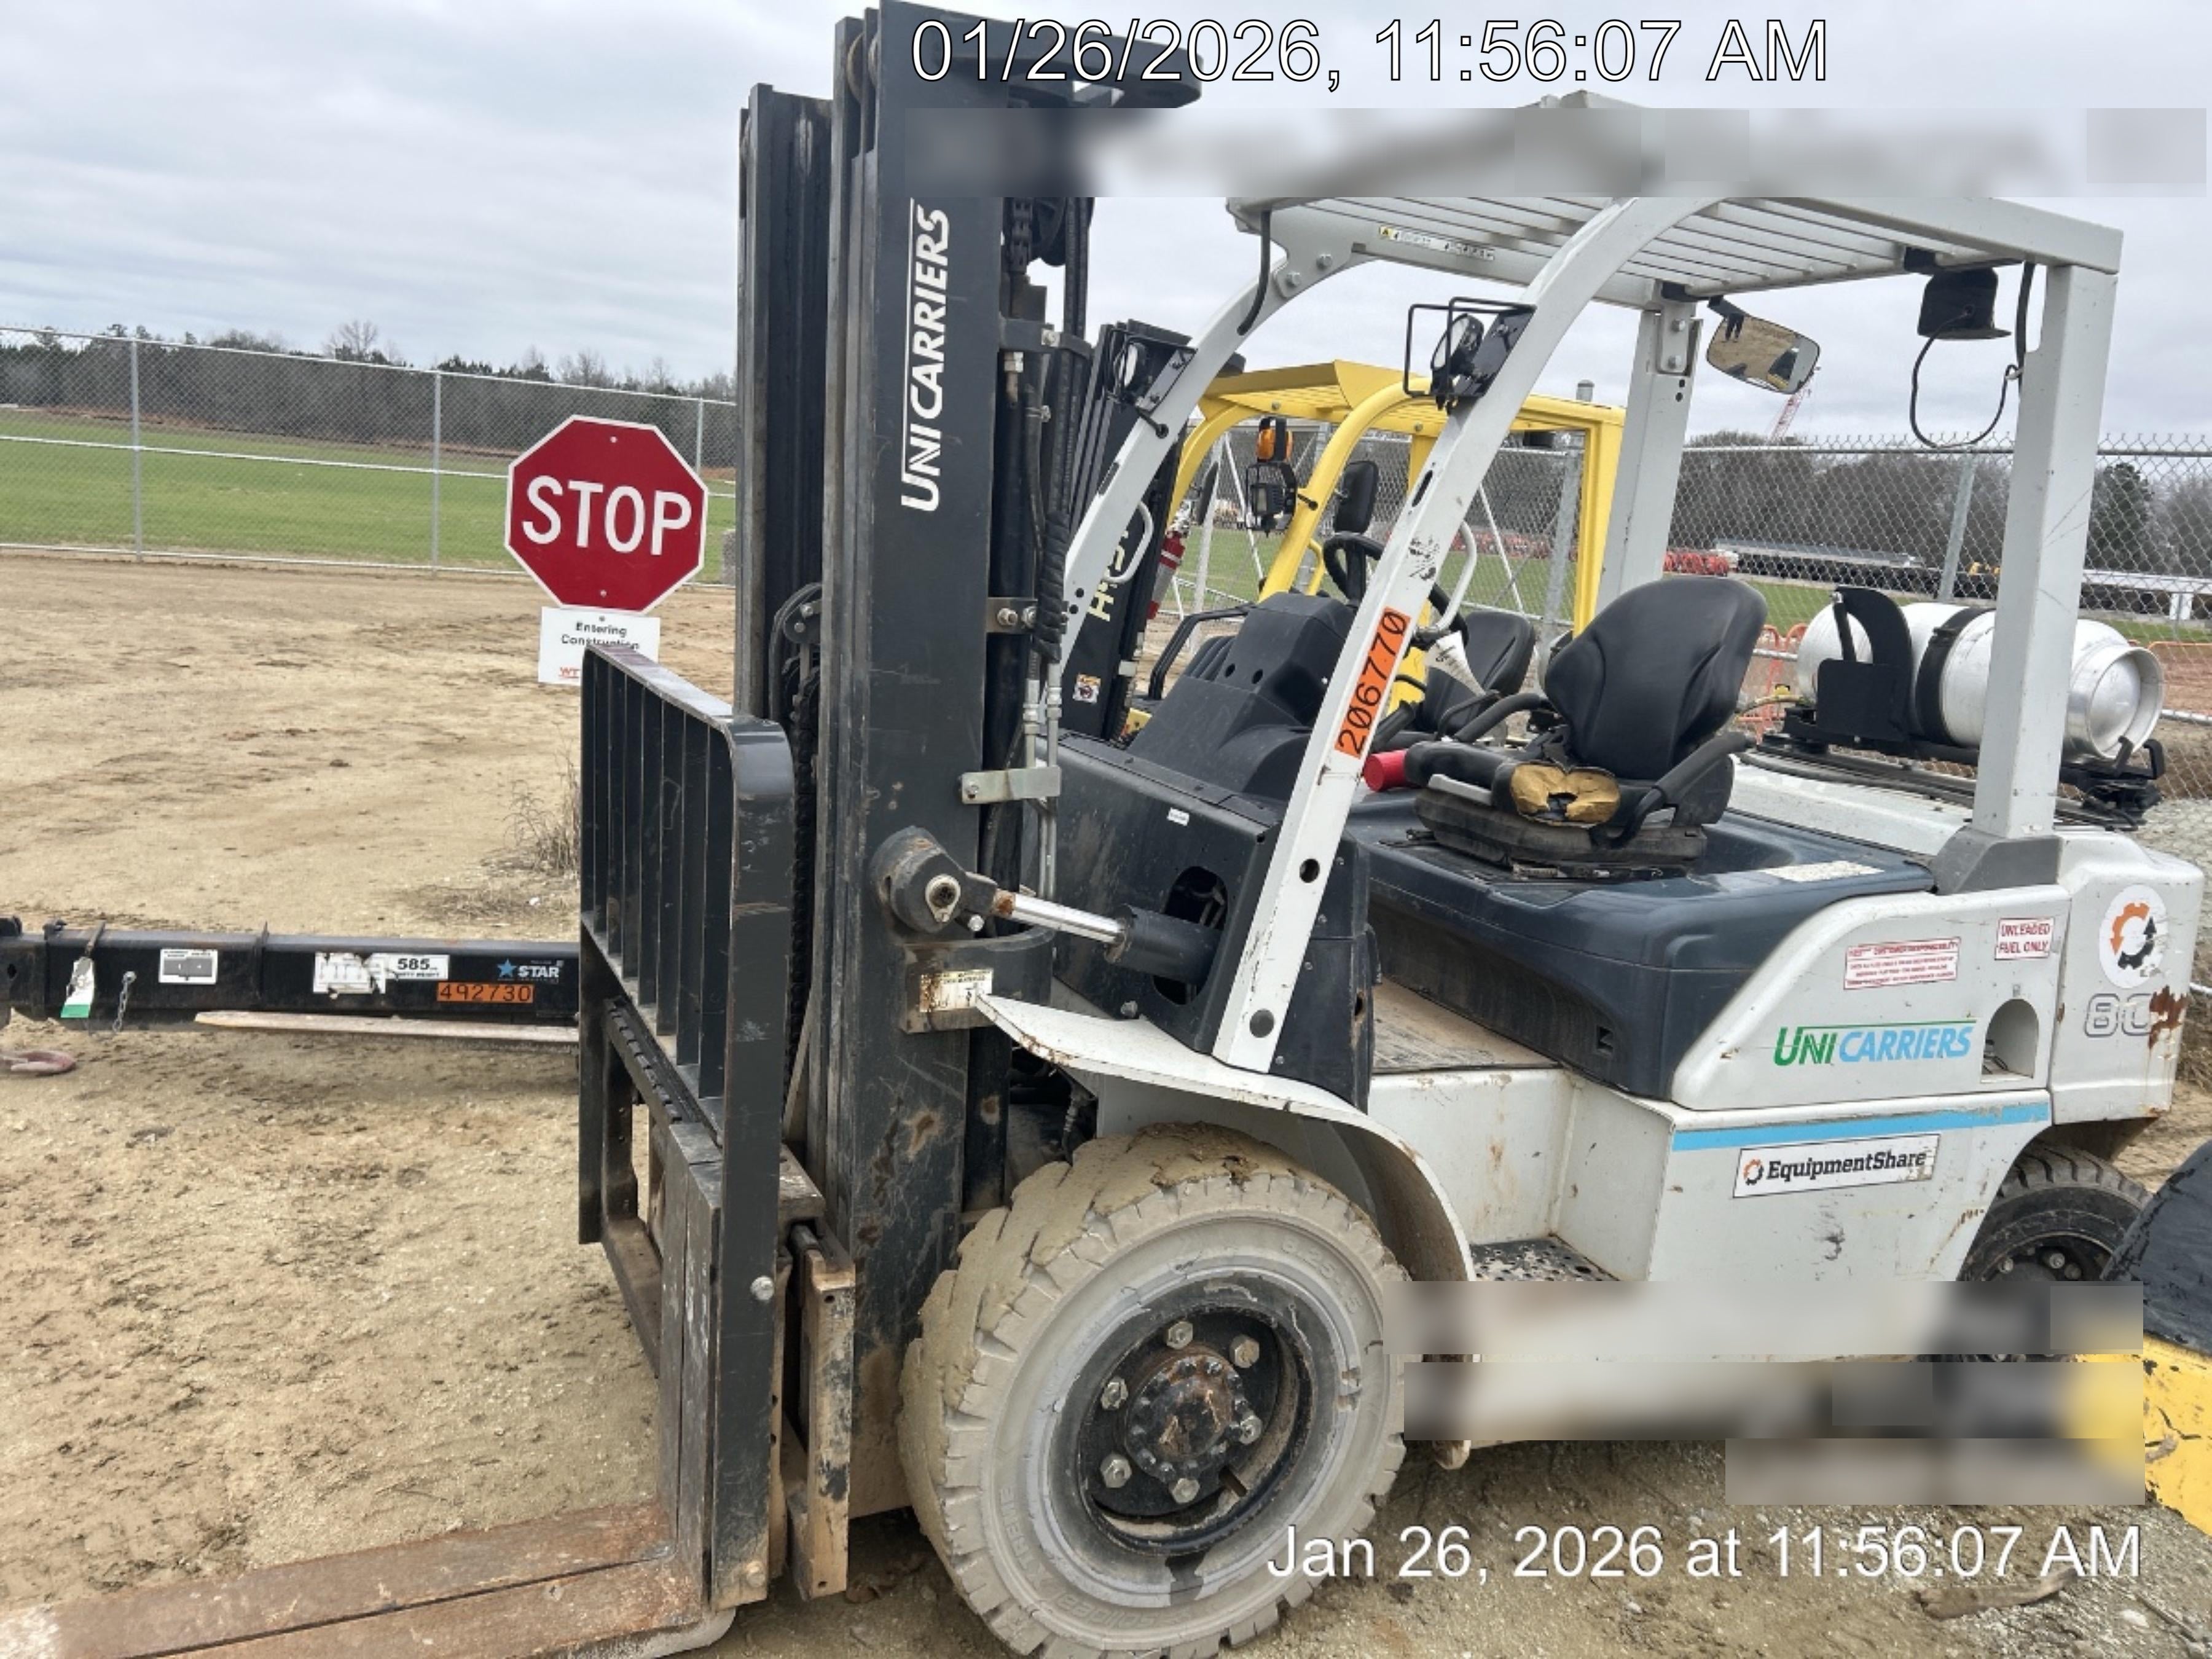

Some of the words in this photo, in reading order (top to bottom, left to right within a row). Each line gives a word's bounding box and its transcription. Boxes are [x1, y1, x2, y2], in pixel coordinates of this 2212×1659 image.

[523, 476, 692, 555] STOP
[576, 622, 627, 638] Entering
[562, 633, 640, 649] Construtn
[1338, 611, 1407, 755] 206770
[398, 958, 430, 970] 585
[518, 965, 559, 978] STAR
[439, 984, 531, 1002] 492730
[1766, 1149, 1927, 1182] EquipmentShare
